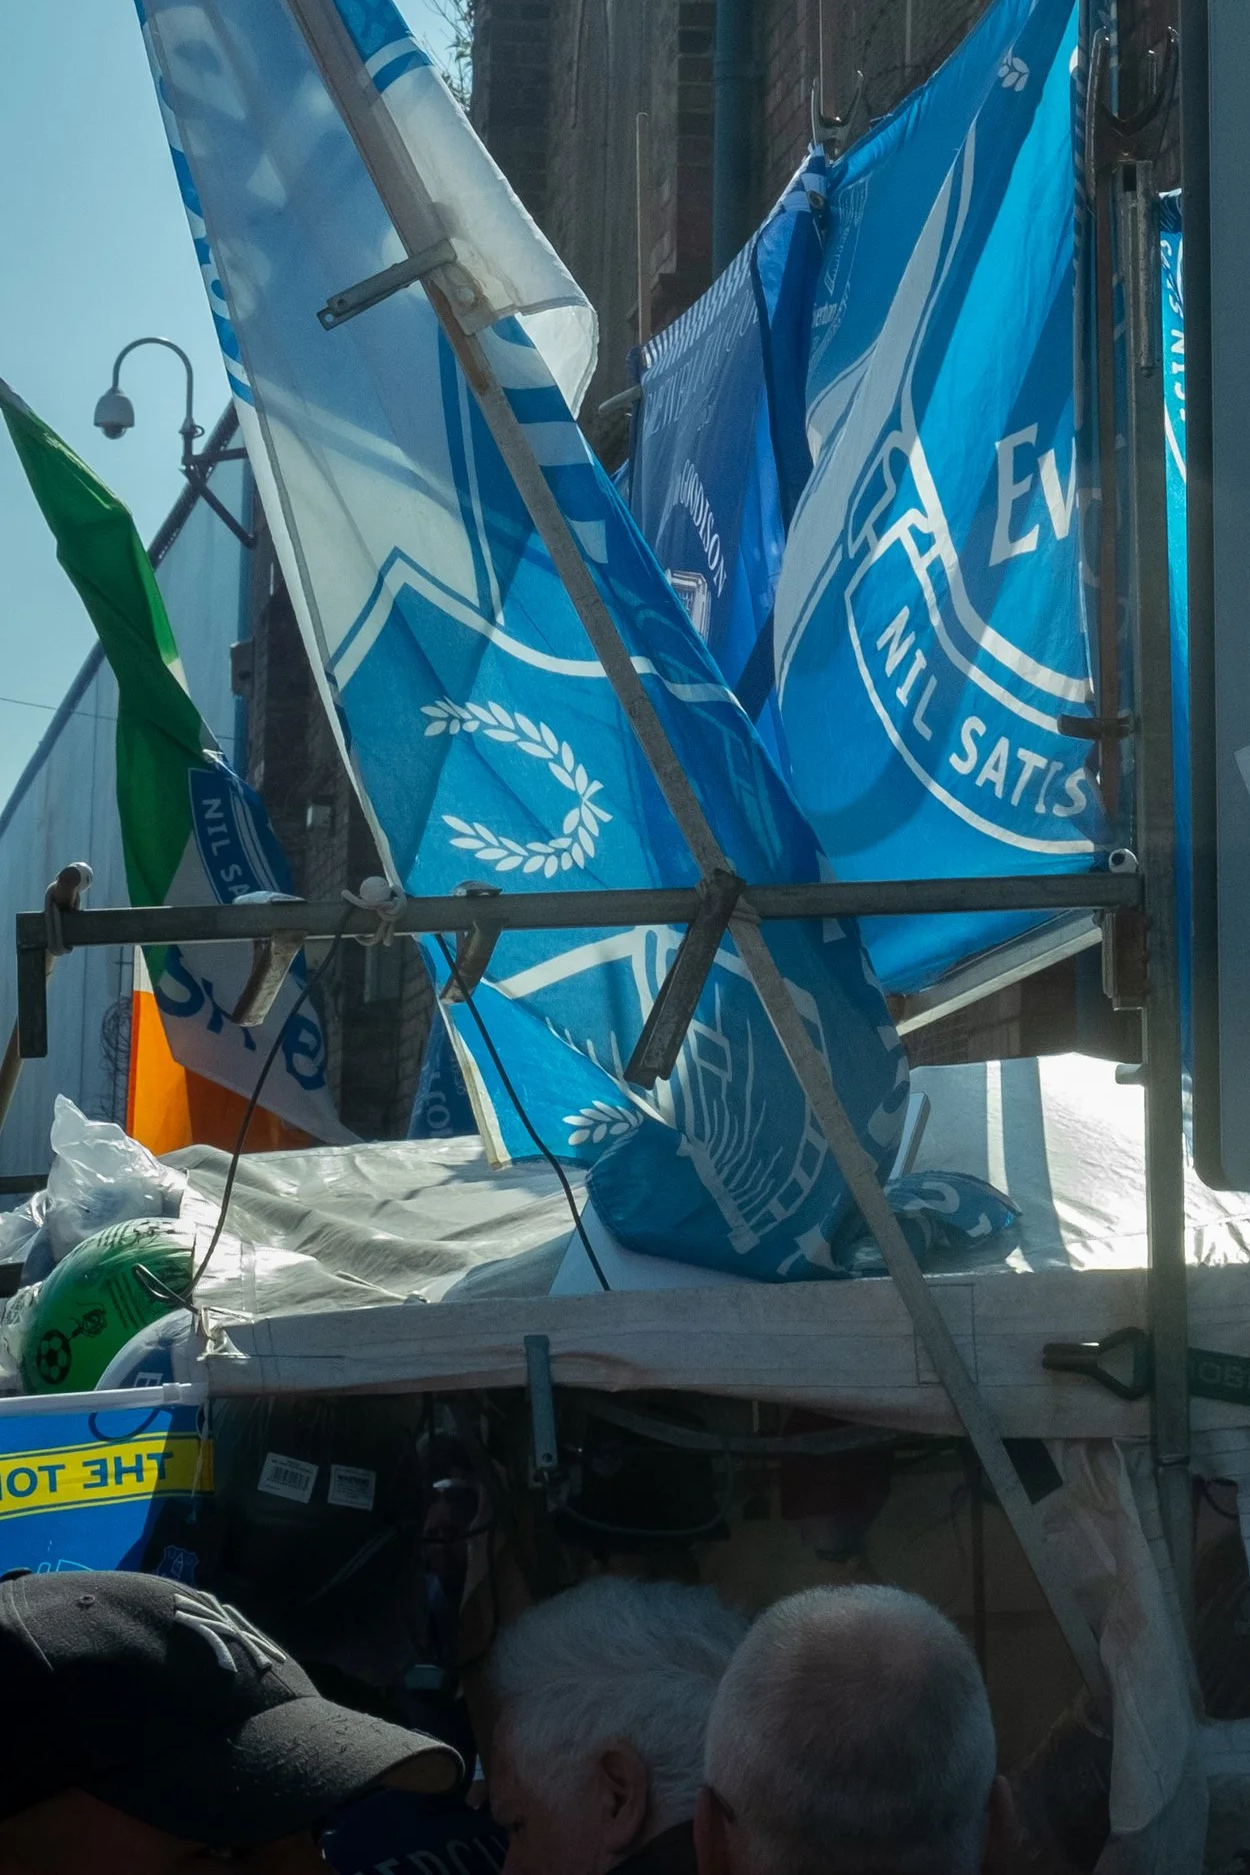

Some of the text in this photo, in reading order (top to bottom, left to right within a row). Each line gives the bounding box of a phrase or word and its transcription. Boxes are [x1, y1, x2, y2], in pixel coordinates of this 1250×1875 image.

[876, 605, 937, 741] NIL
[949, 715, 1090, 818] SATIS
[202, 798, 230, 856] NIL
